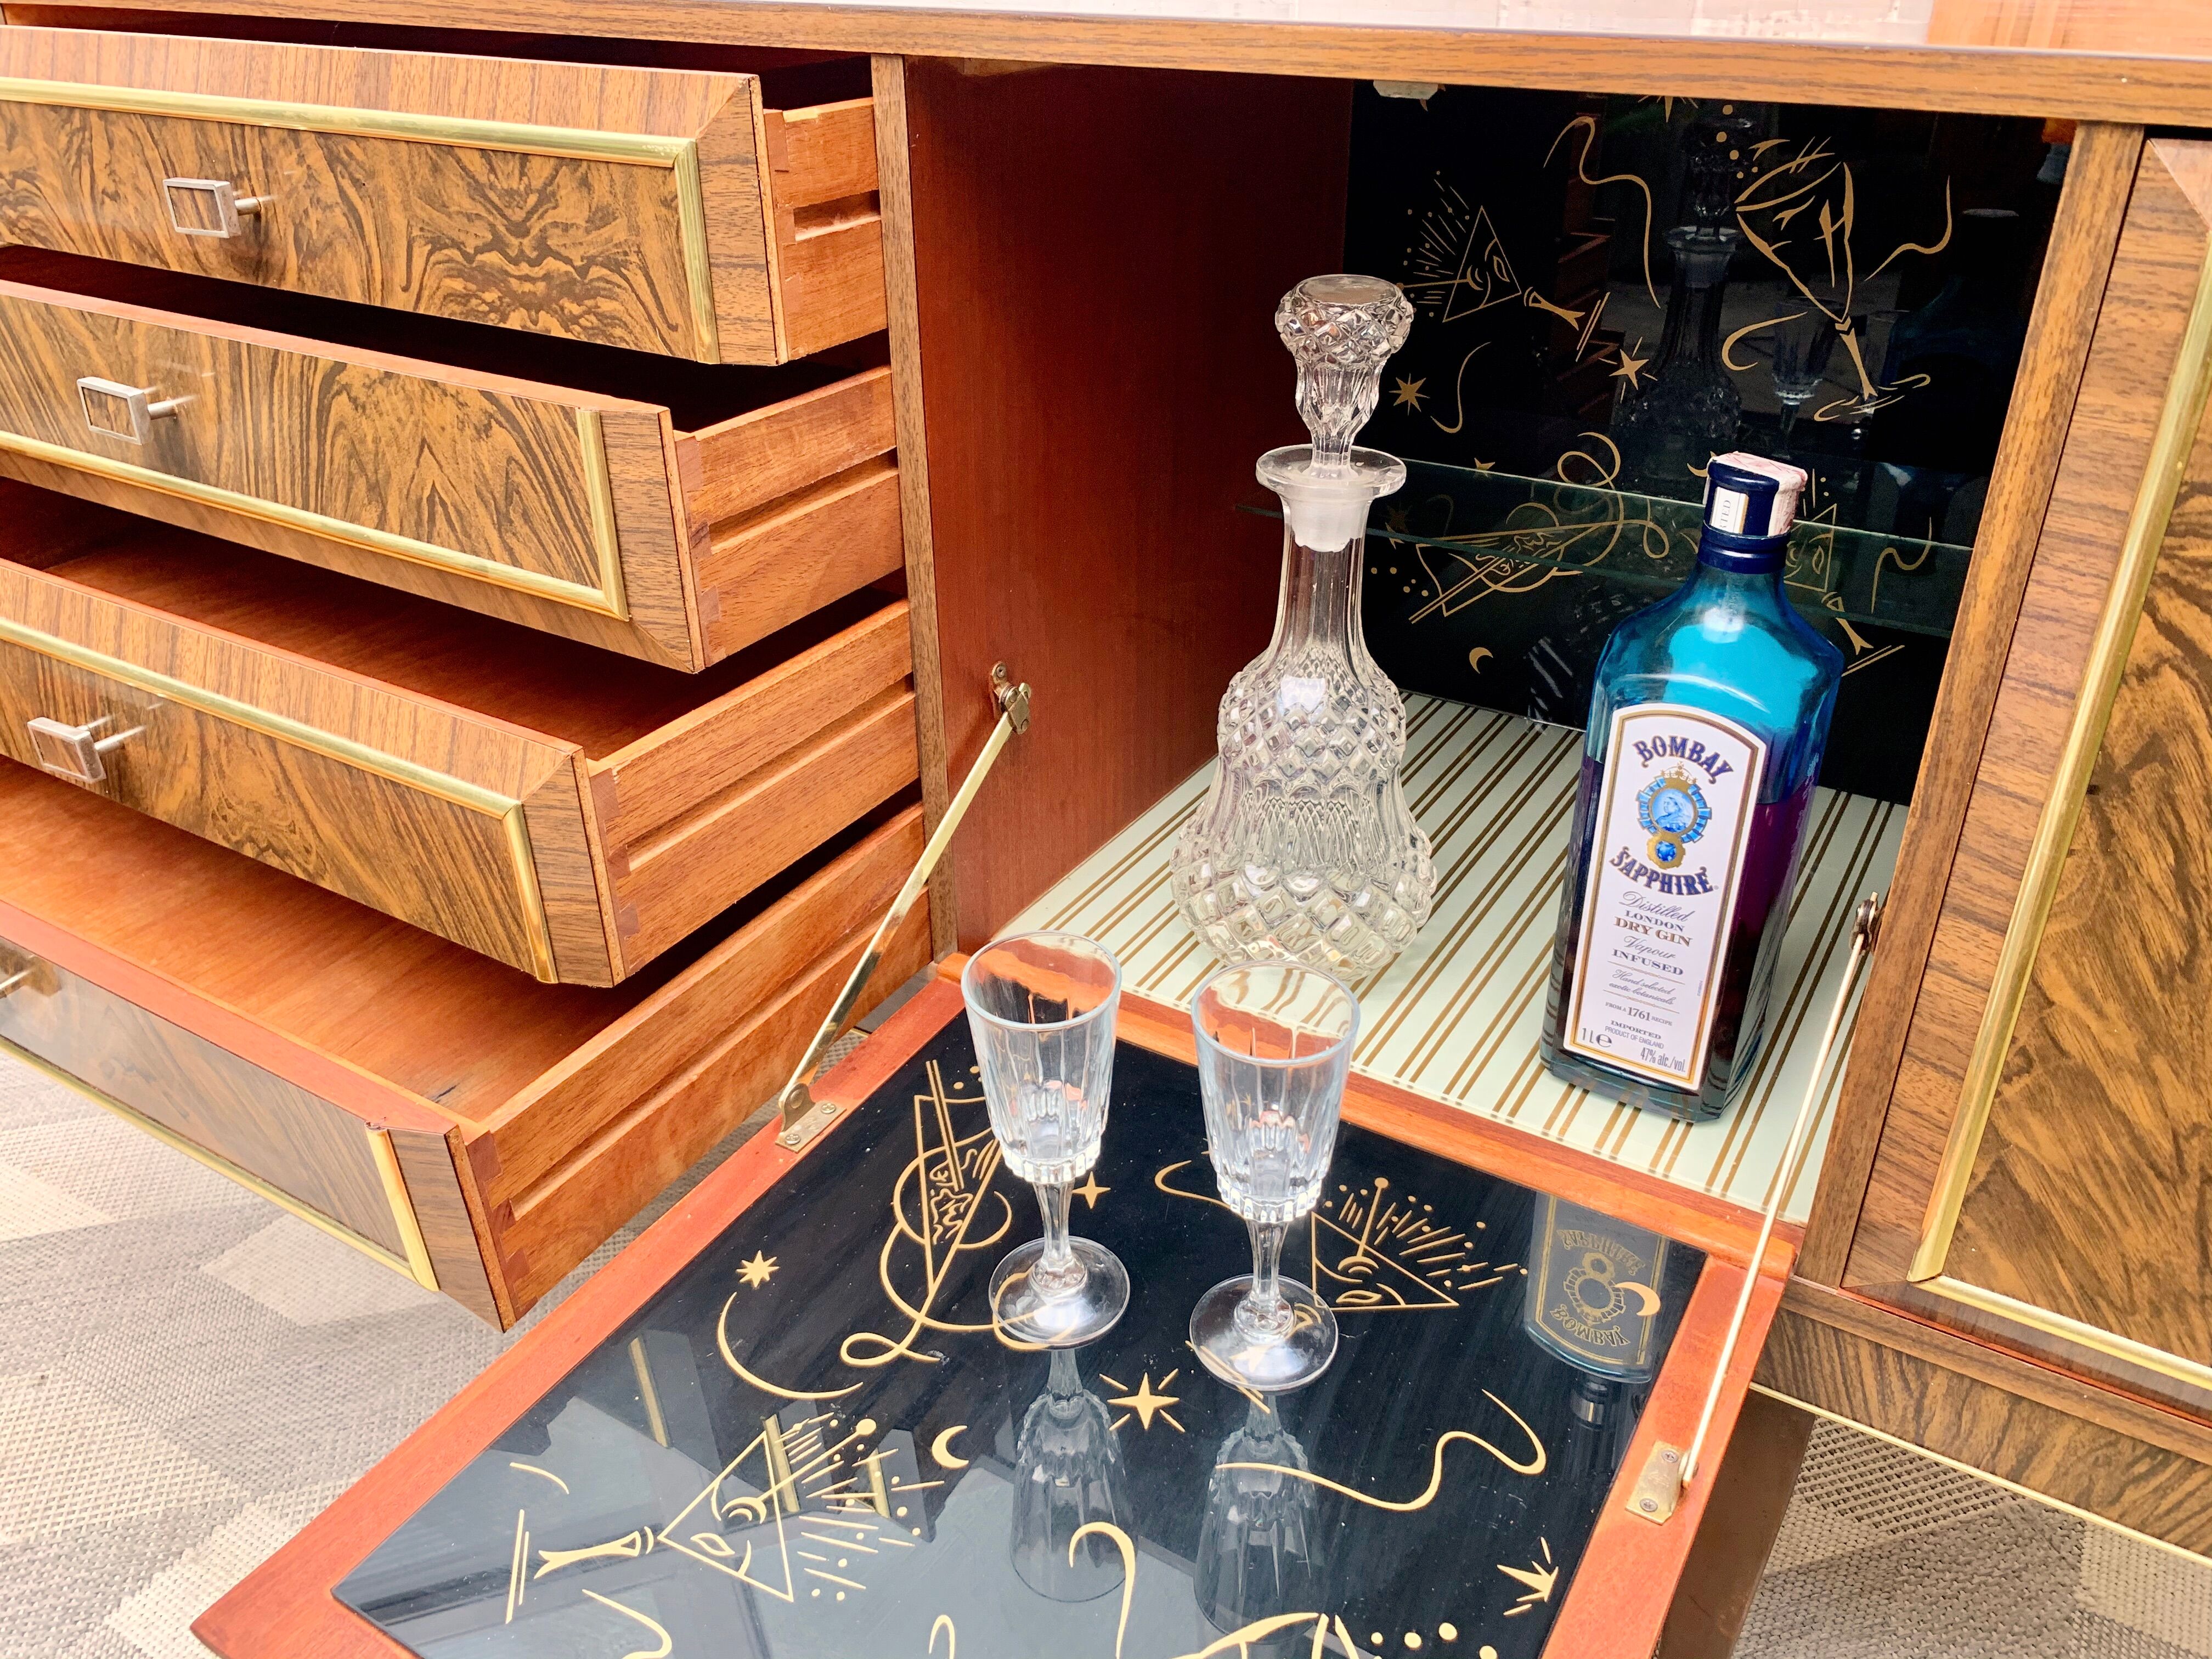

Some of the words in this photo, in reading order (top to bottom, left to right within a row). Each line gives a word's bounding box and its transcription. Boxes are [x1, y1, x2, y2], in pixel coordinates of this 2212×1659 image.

[1632, 735, 1734, 784] BOMBAY
[1609, 846, 1715, 896] SAPPHIRE
[1619, 891, 1695, 922] Distilled
[1613, 916, 1654, 935] DRY
[1655, 929, 1693, 947] GIN
[1625, 910, 1685, 932] LONDON
[1624, 935, 1676, 958] Vapour
[1611, 949, 1683, 975] INFUSED
[1609, 983, 1631, 992] exotic
[1632, 987, 1677, 1005] botanicals
[1612, 969, 1644, 985] Hand
[1640, 982, 1676, 995] selected
[1605, 1002, 1622, 1011] FROM
[1627, 1007, 1650, 1022] 1761
[1651, 1016, 1673, 1026] RECIPE
[1605, 1025, 1629, 1039] PRODUCT
[1638, 1036, 1664, 1049] ENGLAND
[1610, 1019, 1662, 1040] IMPORTED
[1640, 1047, 1656, 1064] 47%
